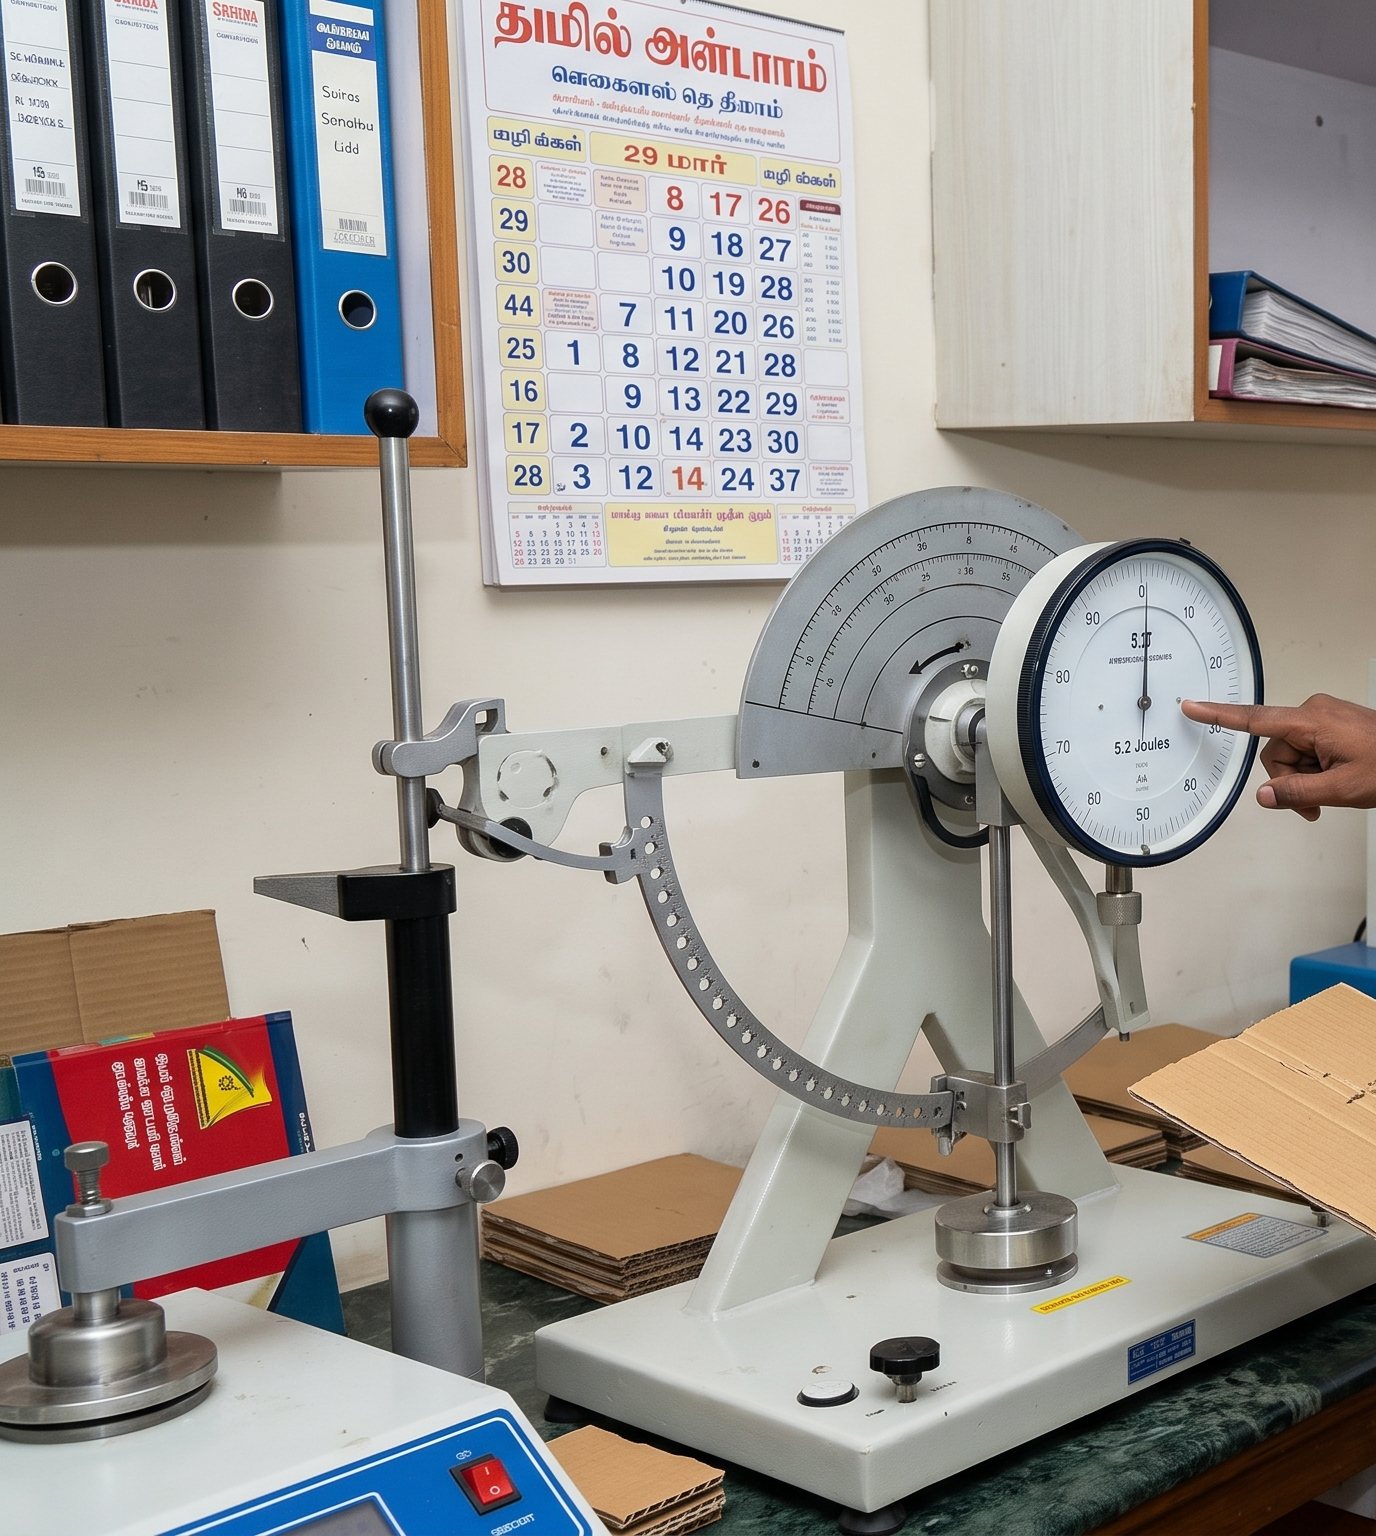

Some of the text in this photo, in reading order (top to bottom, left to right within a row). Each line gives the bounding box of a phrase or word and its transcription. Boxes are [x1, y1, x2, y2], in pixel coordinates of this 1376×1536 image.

[624, 145, 727, 174] 29 மார்
[497, 165, 526, 188] 28
[667, 186, 683, 211] 8
[710, 192, 742, 217] 17
[758, 198, 790, 224] 26
[500, 208, 528, 232] 29
[669, 226, 685, 251] 9
[711, 232, 743, 257] 18
[759, 236, 791, 262] 27
[503, 250, 792, 301] 30 10 19 28
[504, 294, 533, 317] 44
[619, 302, 636, 327] 7
[664, 306, 693, 331] 11
[714, 310, 747, 335] 20
[763, 314, 794, 339] 26
[507, 337, 796, 377] 25 1 8 12 21 28
[510, 380, 538, 402] 16
[624, 384, 641, 409] 9
[668, 386, 701, 411] 13
[718, 389, 750, 413] 22
[766, 392, 797, 416] 29
[512, 422, 798, 454] 17 2 10 14 23 30
[514, 465, 542, 486] 28
[573, 464, 591, 489] 3
[619, 465, 653, 490] 12
[672, 466, 704, 490] 14
[721, 468, 754, 491] 24
[770, 468, 800, 491] 37
[1138, 585, 1145, 598] 0
[1085, 606, 1195, 625] 90 10
[1056, 656, 1222, 684] 80 20
[1056, 741, 1070, 754] 70
[1114, 737, 1170, 754] 5.2 Joules
[1183, 778, 1197, 791] 80
[1136, 808, 1150, 821] 50
